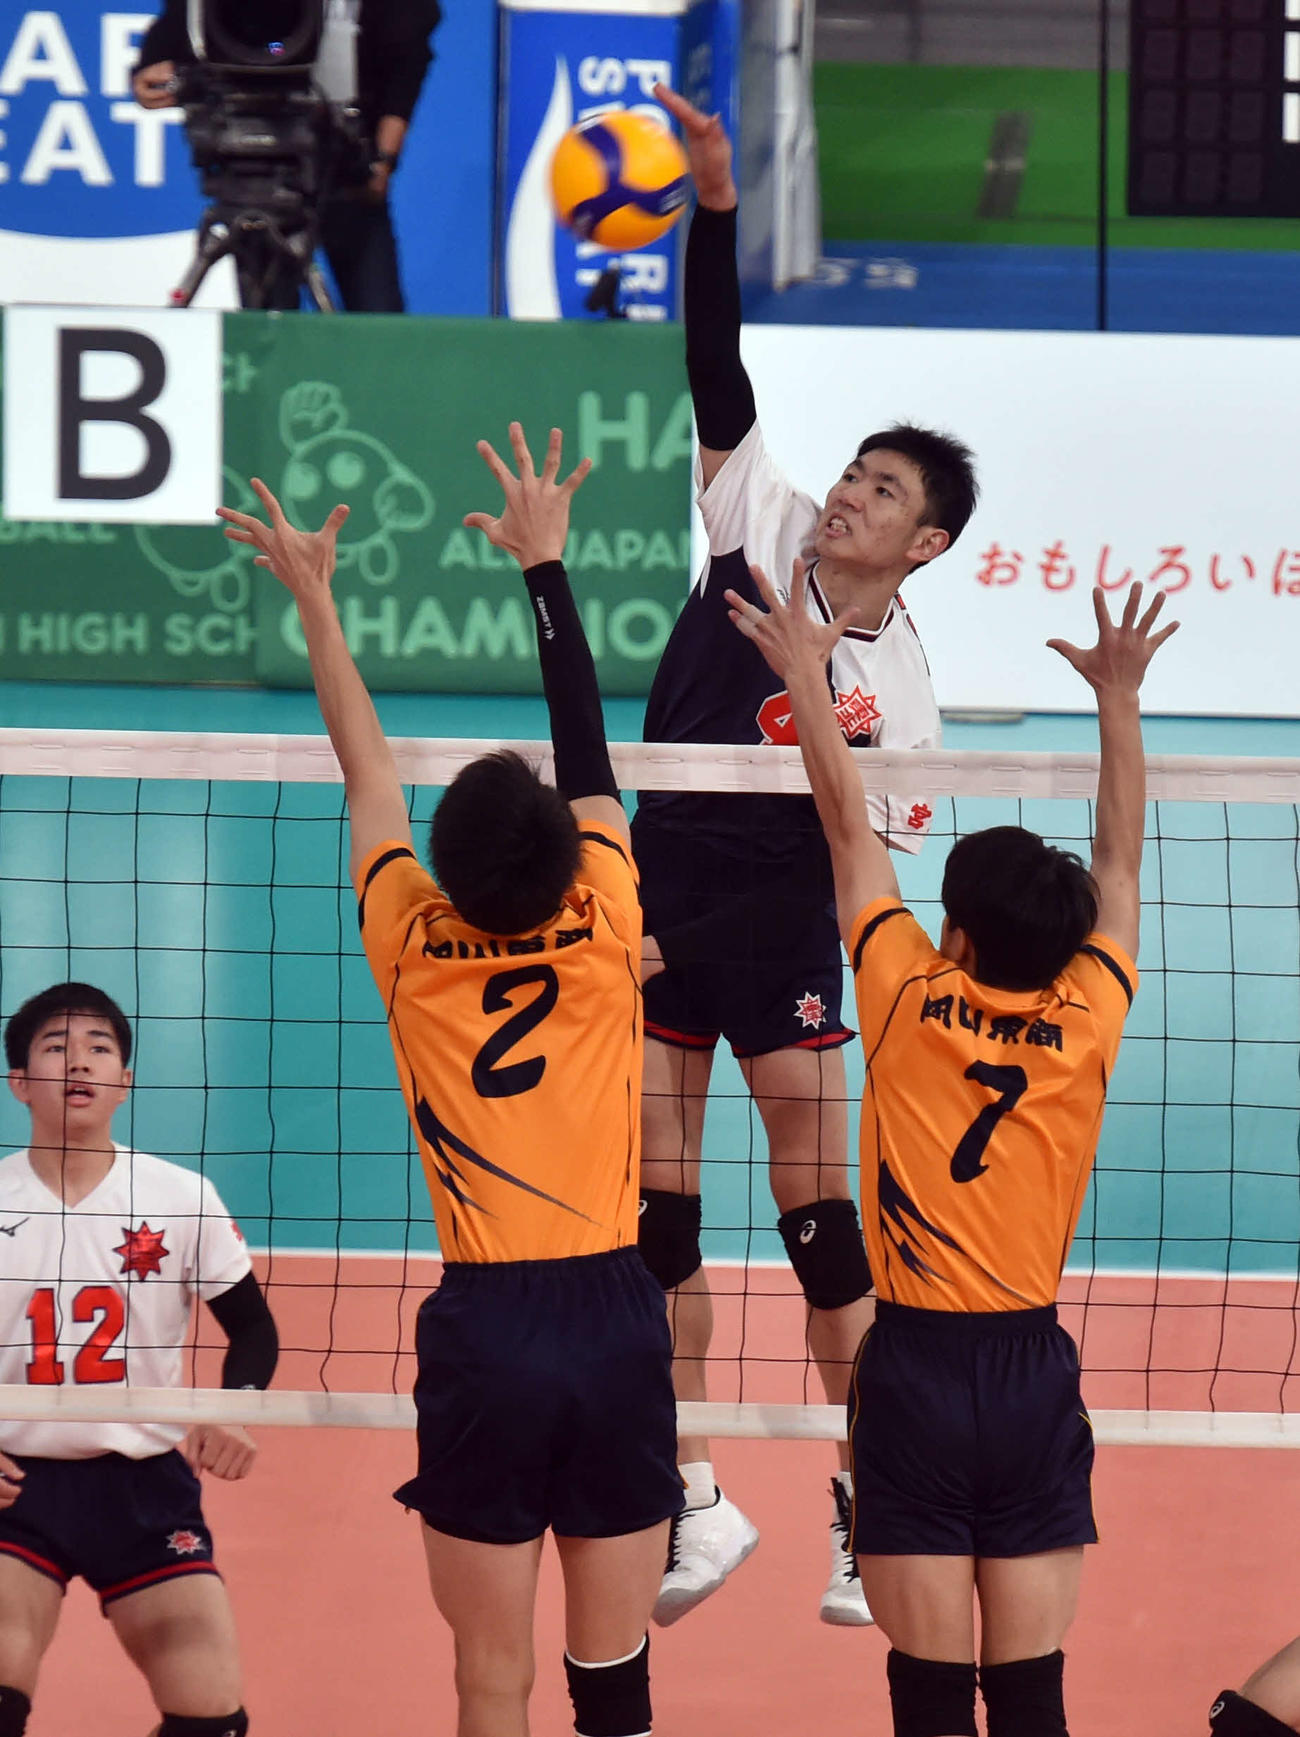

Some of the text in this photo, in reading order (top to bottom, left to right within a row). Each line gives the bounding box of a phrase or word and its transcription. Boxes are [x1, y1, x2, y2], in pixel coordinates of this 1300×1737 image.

[0, 100, 187, 187] AT
[58, 328, 172, 500] B
[17, 611, 148, 654] HIGH
[471, 963, 560, 1099] 2
[950, 1059, 1029, 1184] 7
[25, 1285, 126, 1386] 12
